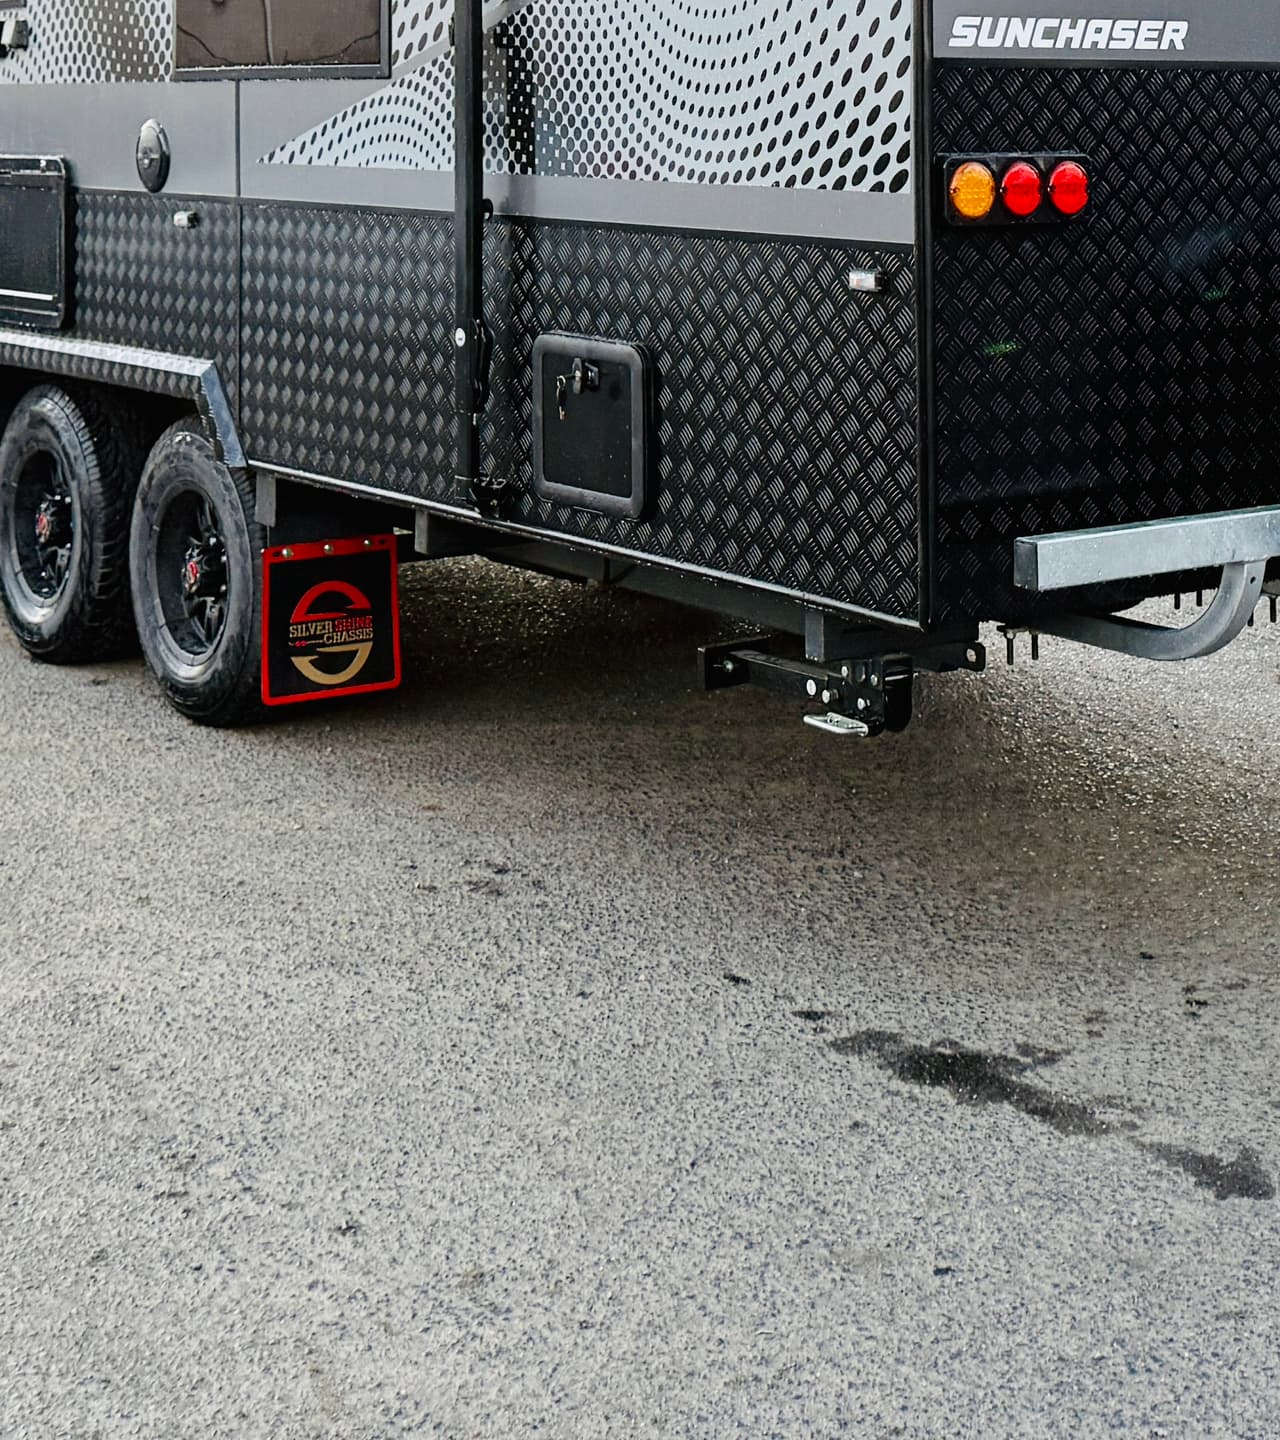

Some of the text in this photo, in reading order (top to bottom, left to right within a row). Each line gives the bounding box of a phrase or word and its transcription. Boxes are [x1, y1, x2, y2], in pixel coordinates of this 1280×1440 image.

[948, 16, 1189, 51] SUNCHASER
[289, 615, 373, 638] SILVER SHINE
[323, 627, 374, 645] CHASSIS
